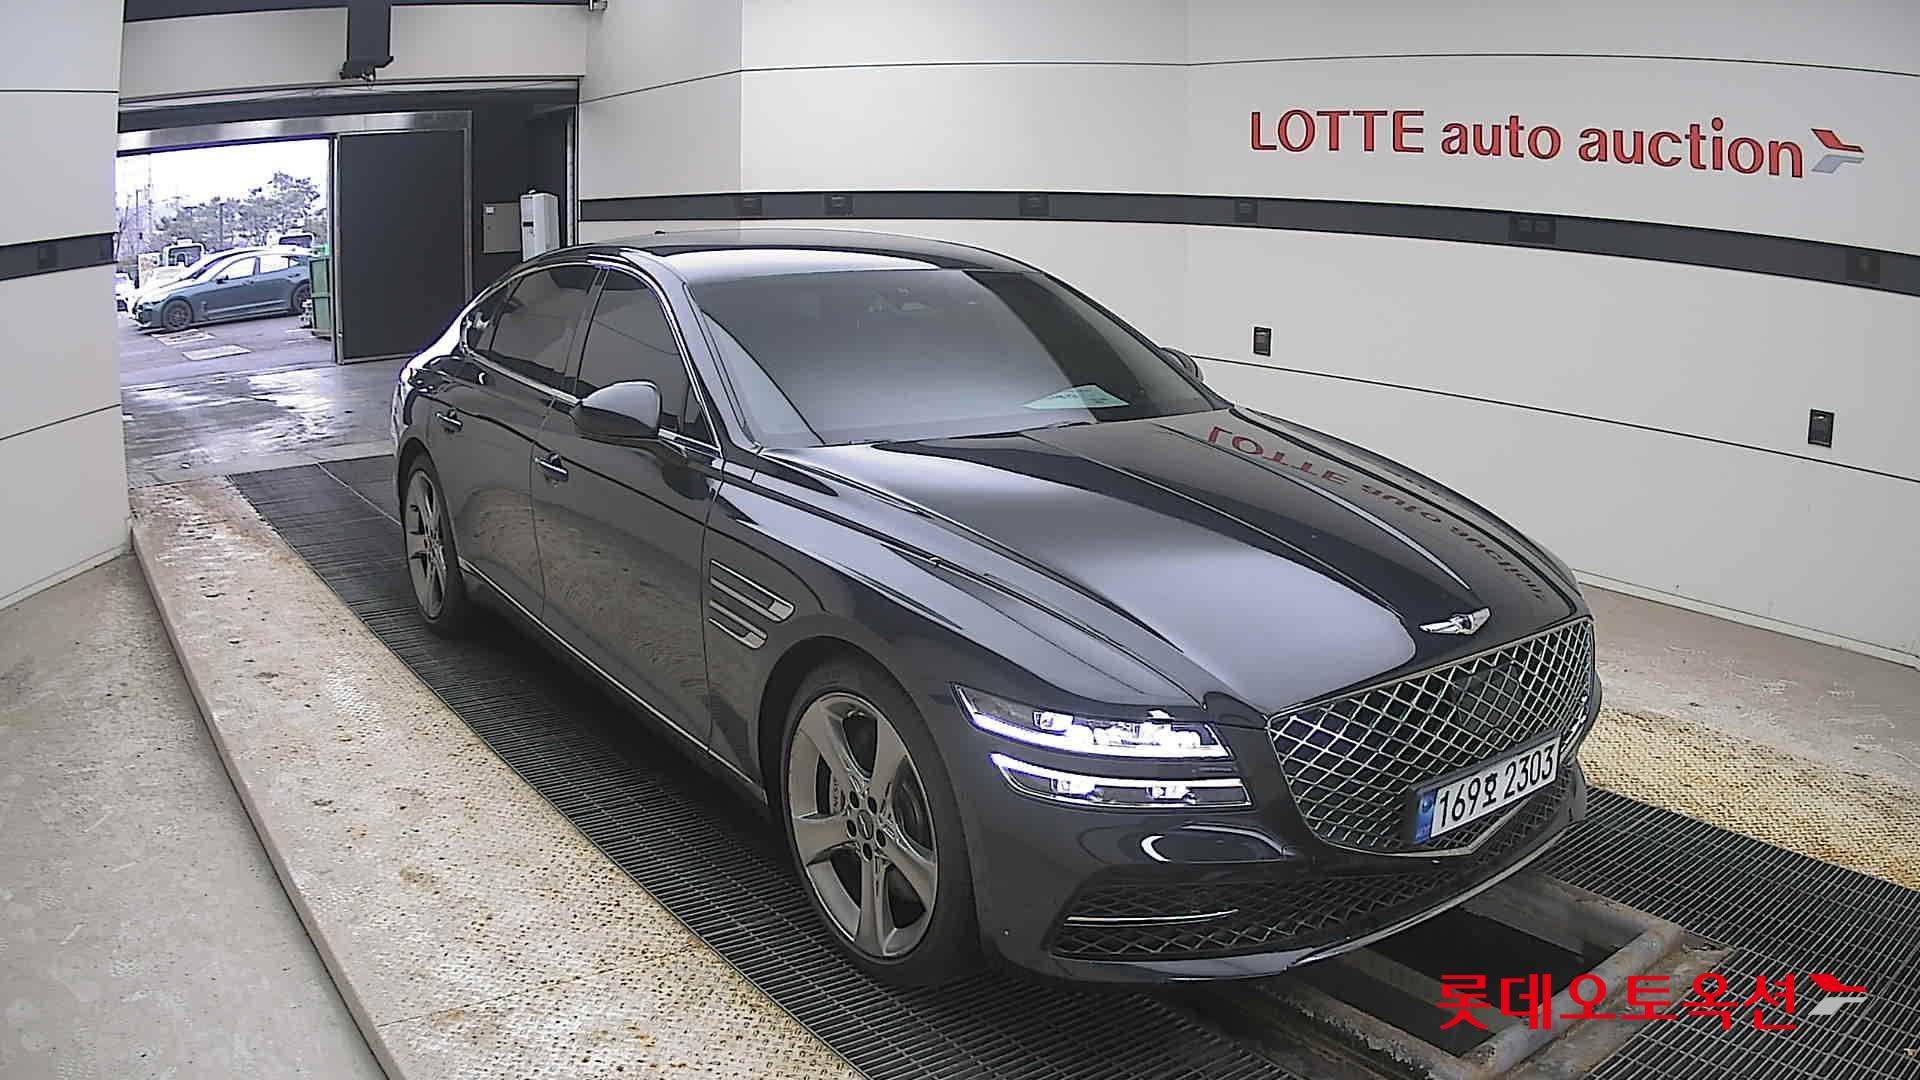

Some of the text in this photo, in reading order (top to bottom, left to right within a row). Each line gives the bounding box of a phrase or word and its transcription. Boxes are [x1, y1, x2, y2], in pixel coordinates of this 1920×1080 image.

[1250, 110, 1804, 178] LOTTE auto auction
[1438, 743, 1556, 829] 169호 2303
